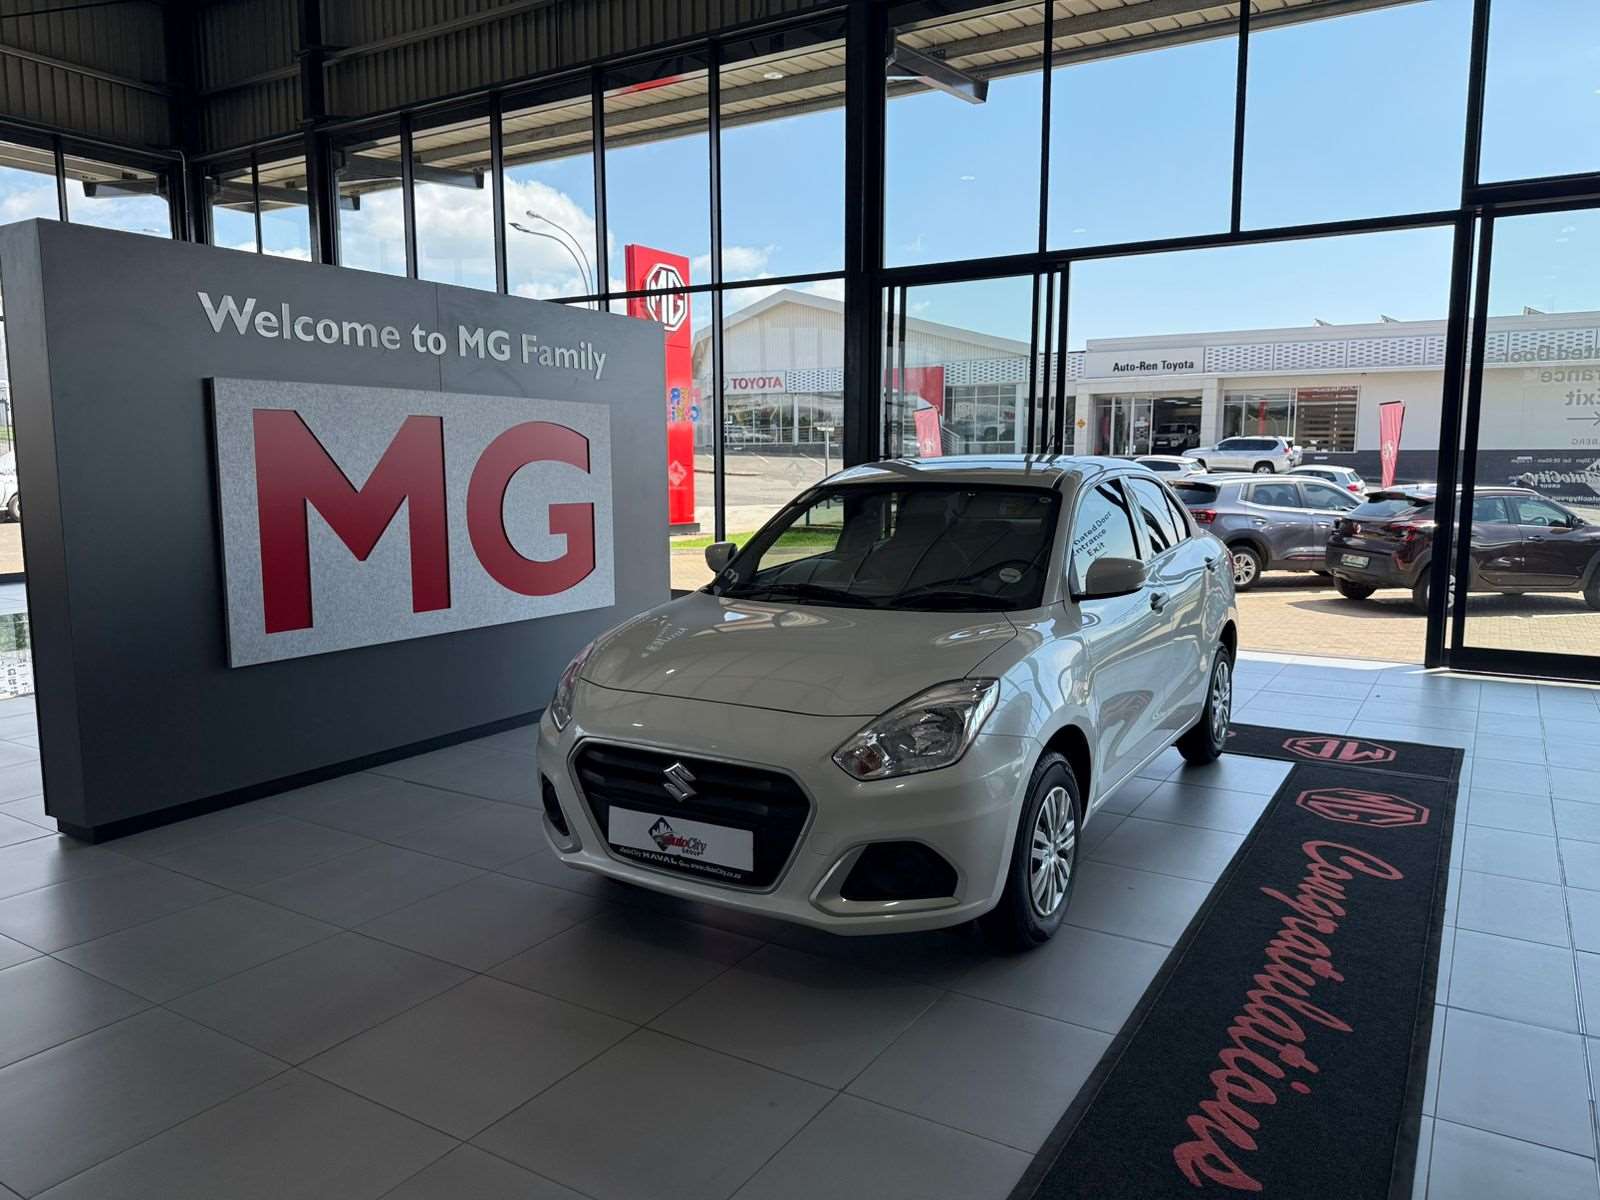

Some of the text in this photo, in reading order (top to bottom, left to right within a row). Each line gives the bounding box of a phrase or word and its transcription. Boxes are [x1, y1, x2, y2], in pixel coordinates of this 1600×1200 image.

[647, 265, 687, 330] MG
[197, 290, 607, 380] Welcome to MG Family
[1113, 359, 1194, 373] Auto-Ren Toyota
[731, 376, 783, 390] TOYOTA
[252, 407, 595, 634] MG
[1095, 511, 1112, 527] Door
[1087, 542, 1105, 556] Exit
[1287, 738, 1392, 763] MG
[1301, 789, 1423, 826] MG
[663, 832, 707, 854] AutoCity
[1172, 839, 1405, 1192] Congratulations
